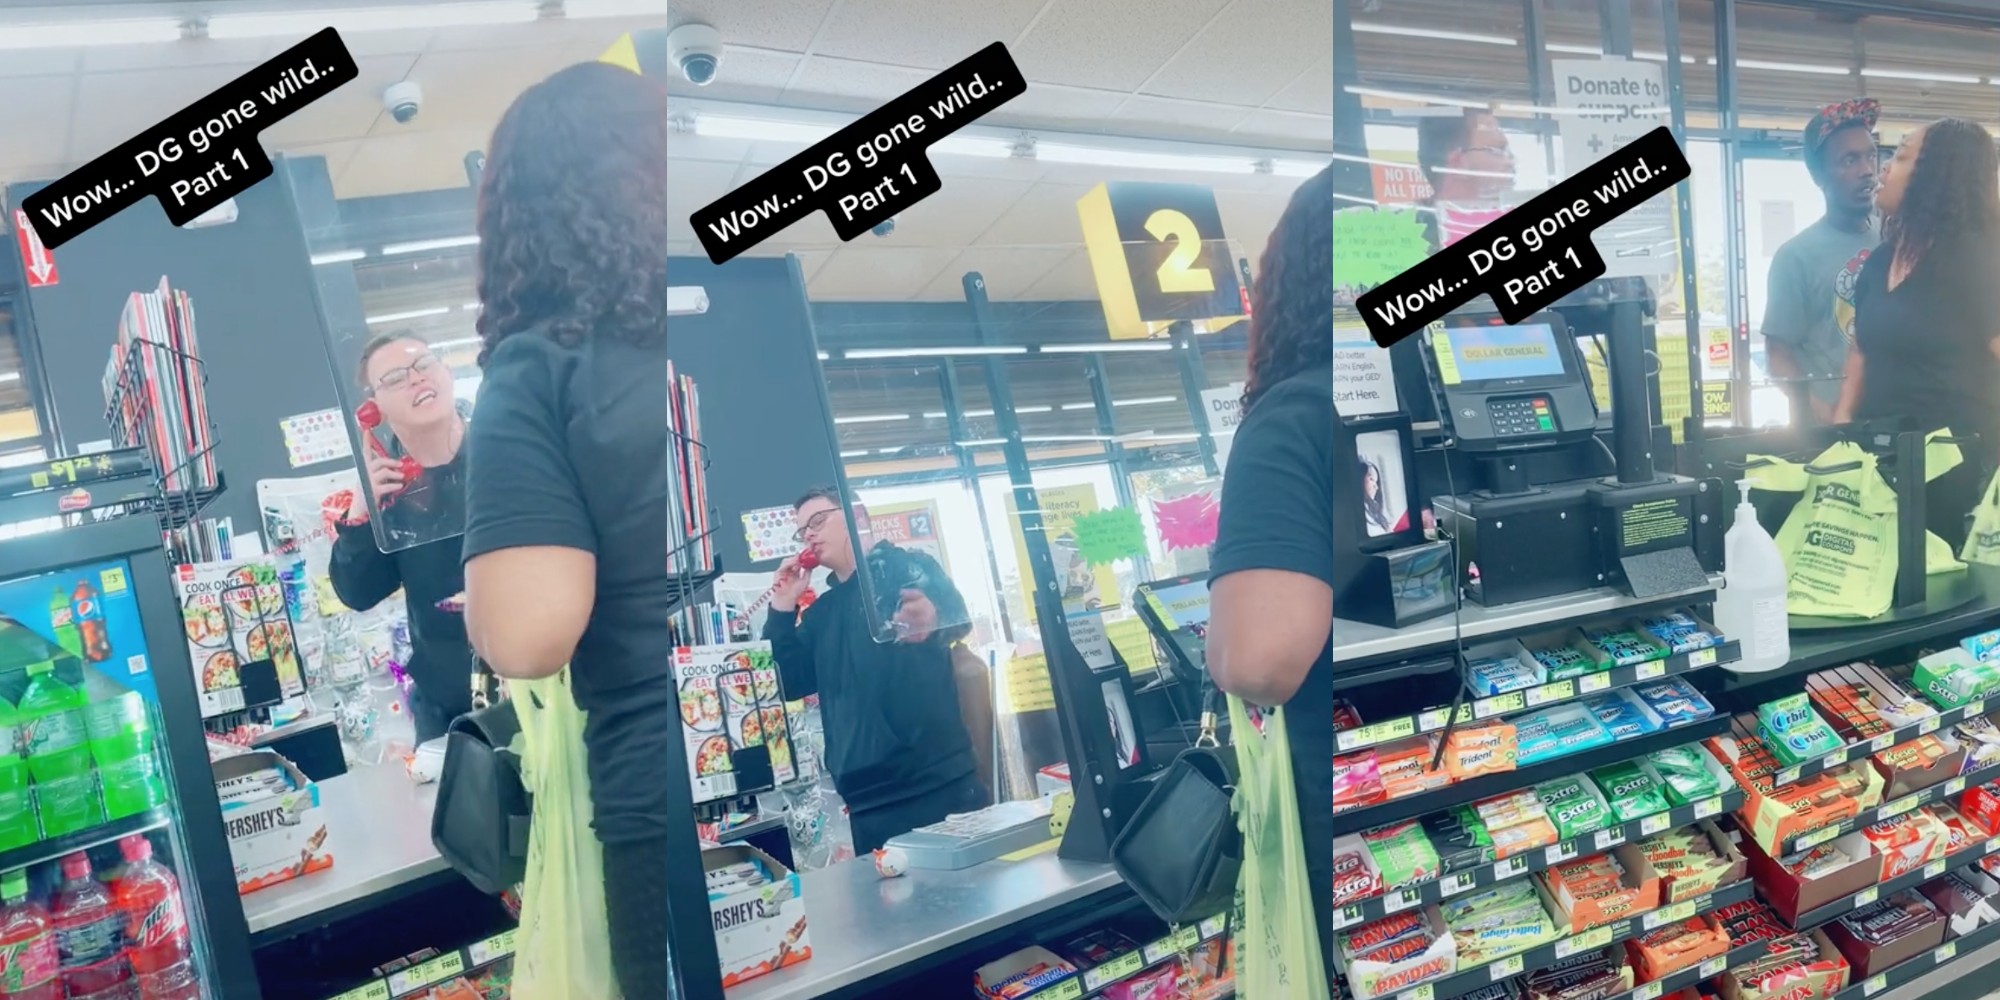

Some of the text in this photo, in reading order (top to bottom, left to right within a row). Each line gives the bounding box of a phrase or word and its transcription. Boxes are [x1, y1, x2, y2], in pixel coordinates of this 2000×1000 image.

[1567, 76, 1661, 97] Donate to
[1577, 102, 1658, 123] support
[1385, 168, 1403, 182] NO
[1384, 184, 1406, 197] ALL
[1144, 208, 1215, 292] 2
[1503, 346, 1545, 357] GENERAL
[1046, 500, 1080, 510] literacy
[185, 577, 241, 594] COOK ONCE
[199, 594, 216, 605] EAT
[682, 662, 738, 677] COOK ONCE
[695, 678, 712, 688] EAT
[1393, 723, 1411, 733] FREE
[1771, 709, 1807, 734] Orbit
[1787, 730, 1827, 751] Orbit
[1459, 750, 1493, 767] Trident
[1615, 776, 1650, 796] Extra
[1543, 784, 1580, 806] Extra
[1558, 799, 1597, 821] Extra
[1611, 828, 1622, 839] $1
[1562, 842, 1573, 853] $1
[1512, 858, 1523, 869] $1
[1460, 874, 1471, 885] $1
[1404, 890, 1416, 901] $1
[713, 898, 766, 931] RSHEY'S
[1345, 906, 1358, 918] $1
[1351, 916, 1419, 952] PAYDAY
[1480, 925, 1542, 939] Butterfinger
[441, 957, 461, 970] FREE
[1125, 955, 1139, 967] FREE
[1375, 955, 1444, 996] PAYDAY
[366, 985, 386, 999] FREE
[1062, 982, 1080, 994] FREE
